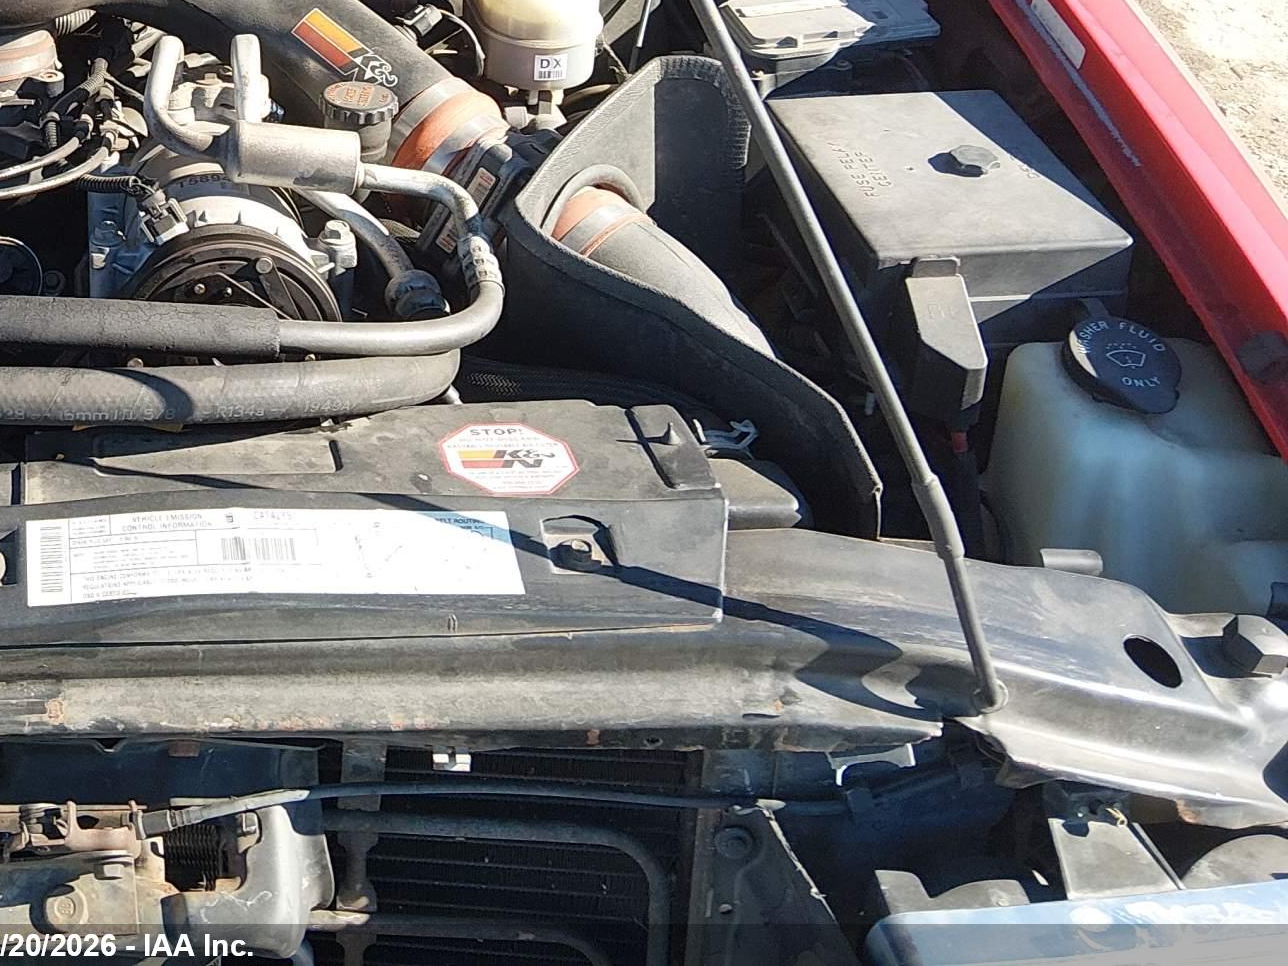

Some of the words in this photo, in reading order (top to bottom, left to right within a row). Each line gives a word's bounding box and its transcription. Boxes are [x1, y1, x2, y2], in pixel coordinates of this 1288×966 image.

[1077, 320, 1109, 354] WASHER
[1119, 322, 1166, 352] FLUID
[1122, 376, 1161, 388] ONLY
[470, 428, 522, 436] STOP!
[132, 515, 162, 523] VEHICLE
[165, 513, 202, 521] EMISSION
[122, 523, 155, 532] CONTROL
[159, 521, 213, 530] INFORMATION
